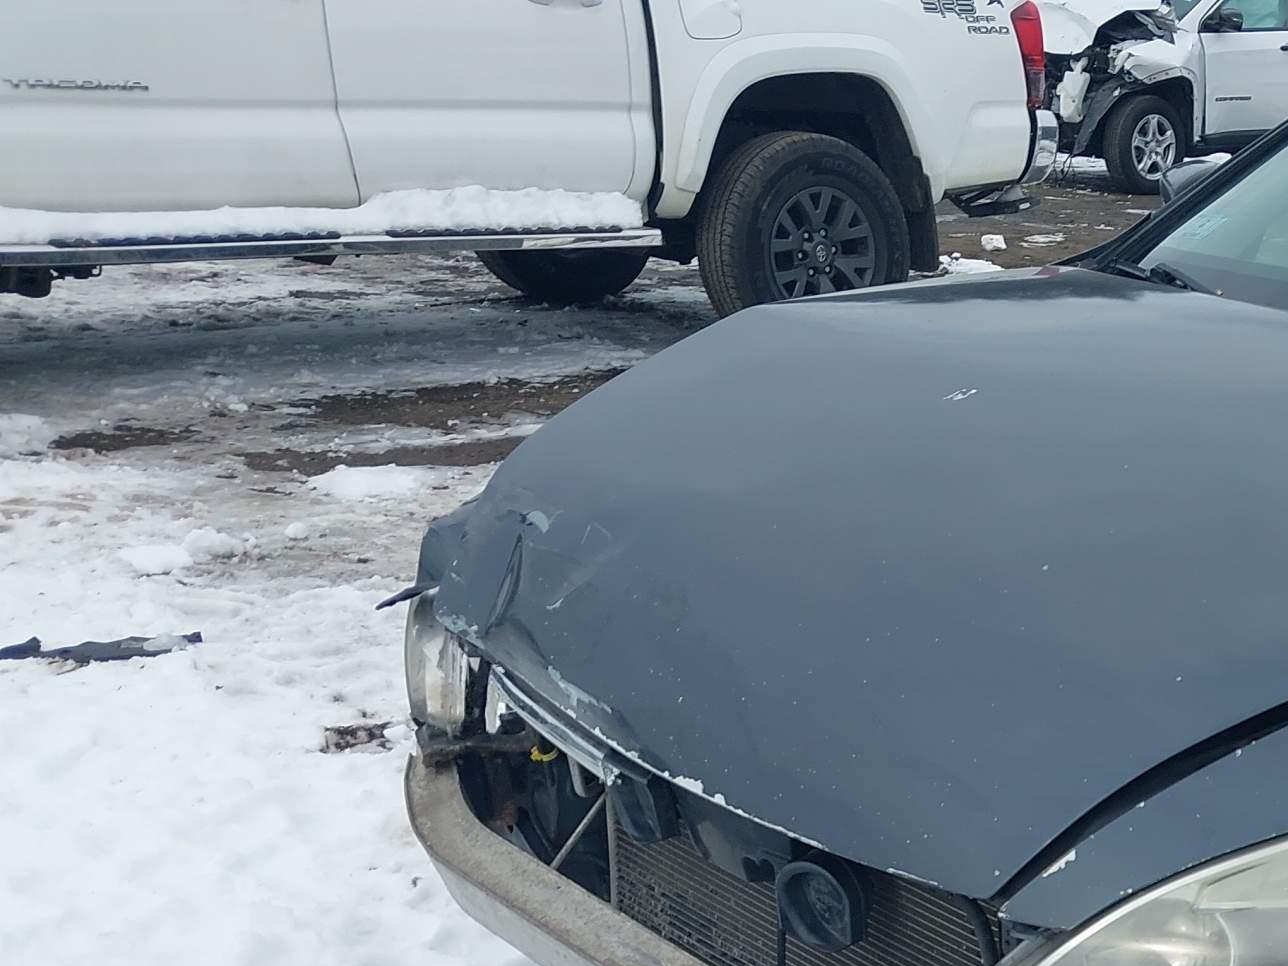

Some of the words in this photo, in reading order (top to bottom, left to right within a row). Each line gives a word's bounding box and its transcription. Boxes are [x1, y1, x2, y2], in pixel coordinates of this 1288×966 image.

[963, 15, 996, 24] OFF
[967, 25, 1010, 35] ROAD
[2, 79, 149, 91] TACOMA
